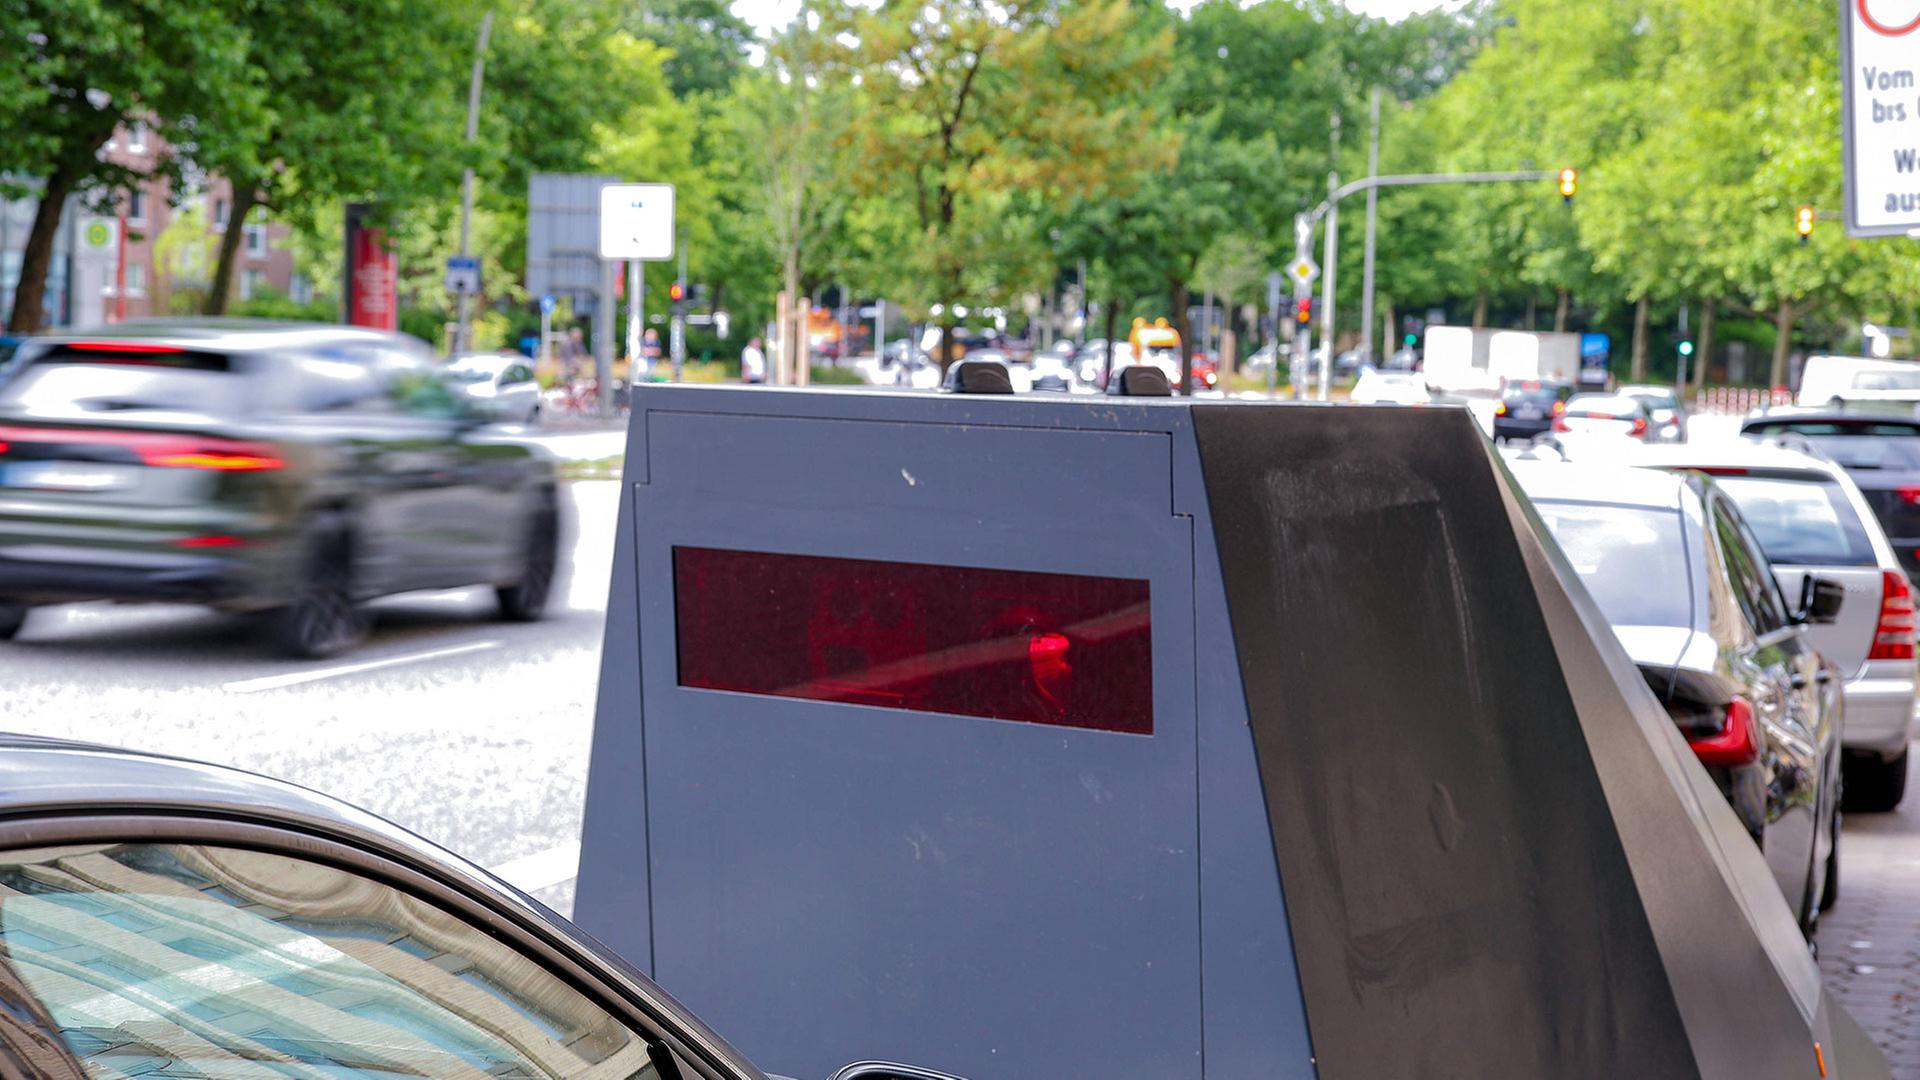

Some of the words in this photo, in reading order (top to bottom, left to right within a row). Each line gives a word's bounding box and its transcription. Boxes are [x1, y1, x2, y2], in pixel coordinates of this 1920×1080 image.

[1862, 66, 1914, 91] Vom
[1872, 98, 1907, 124] bis
[1893, 148, 1920, 174] W
